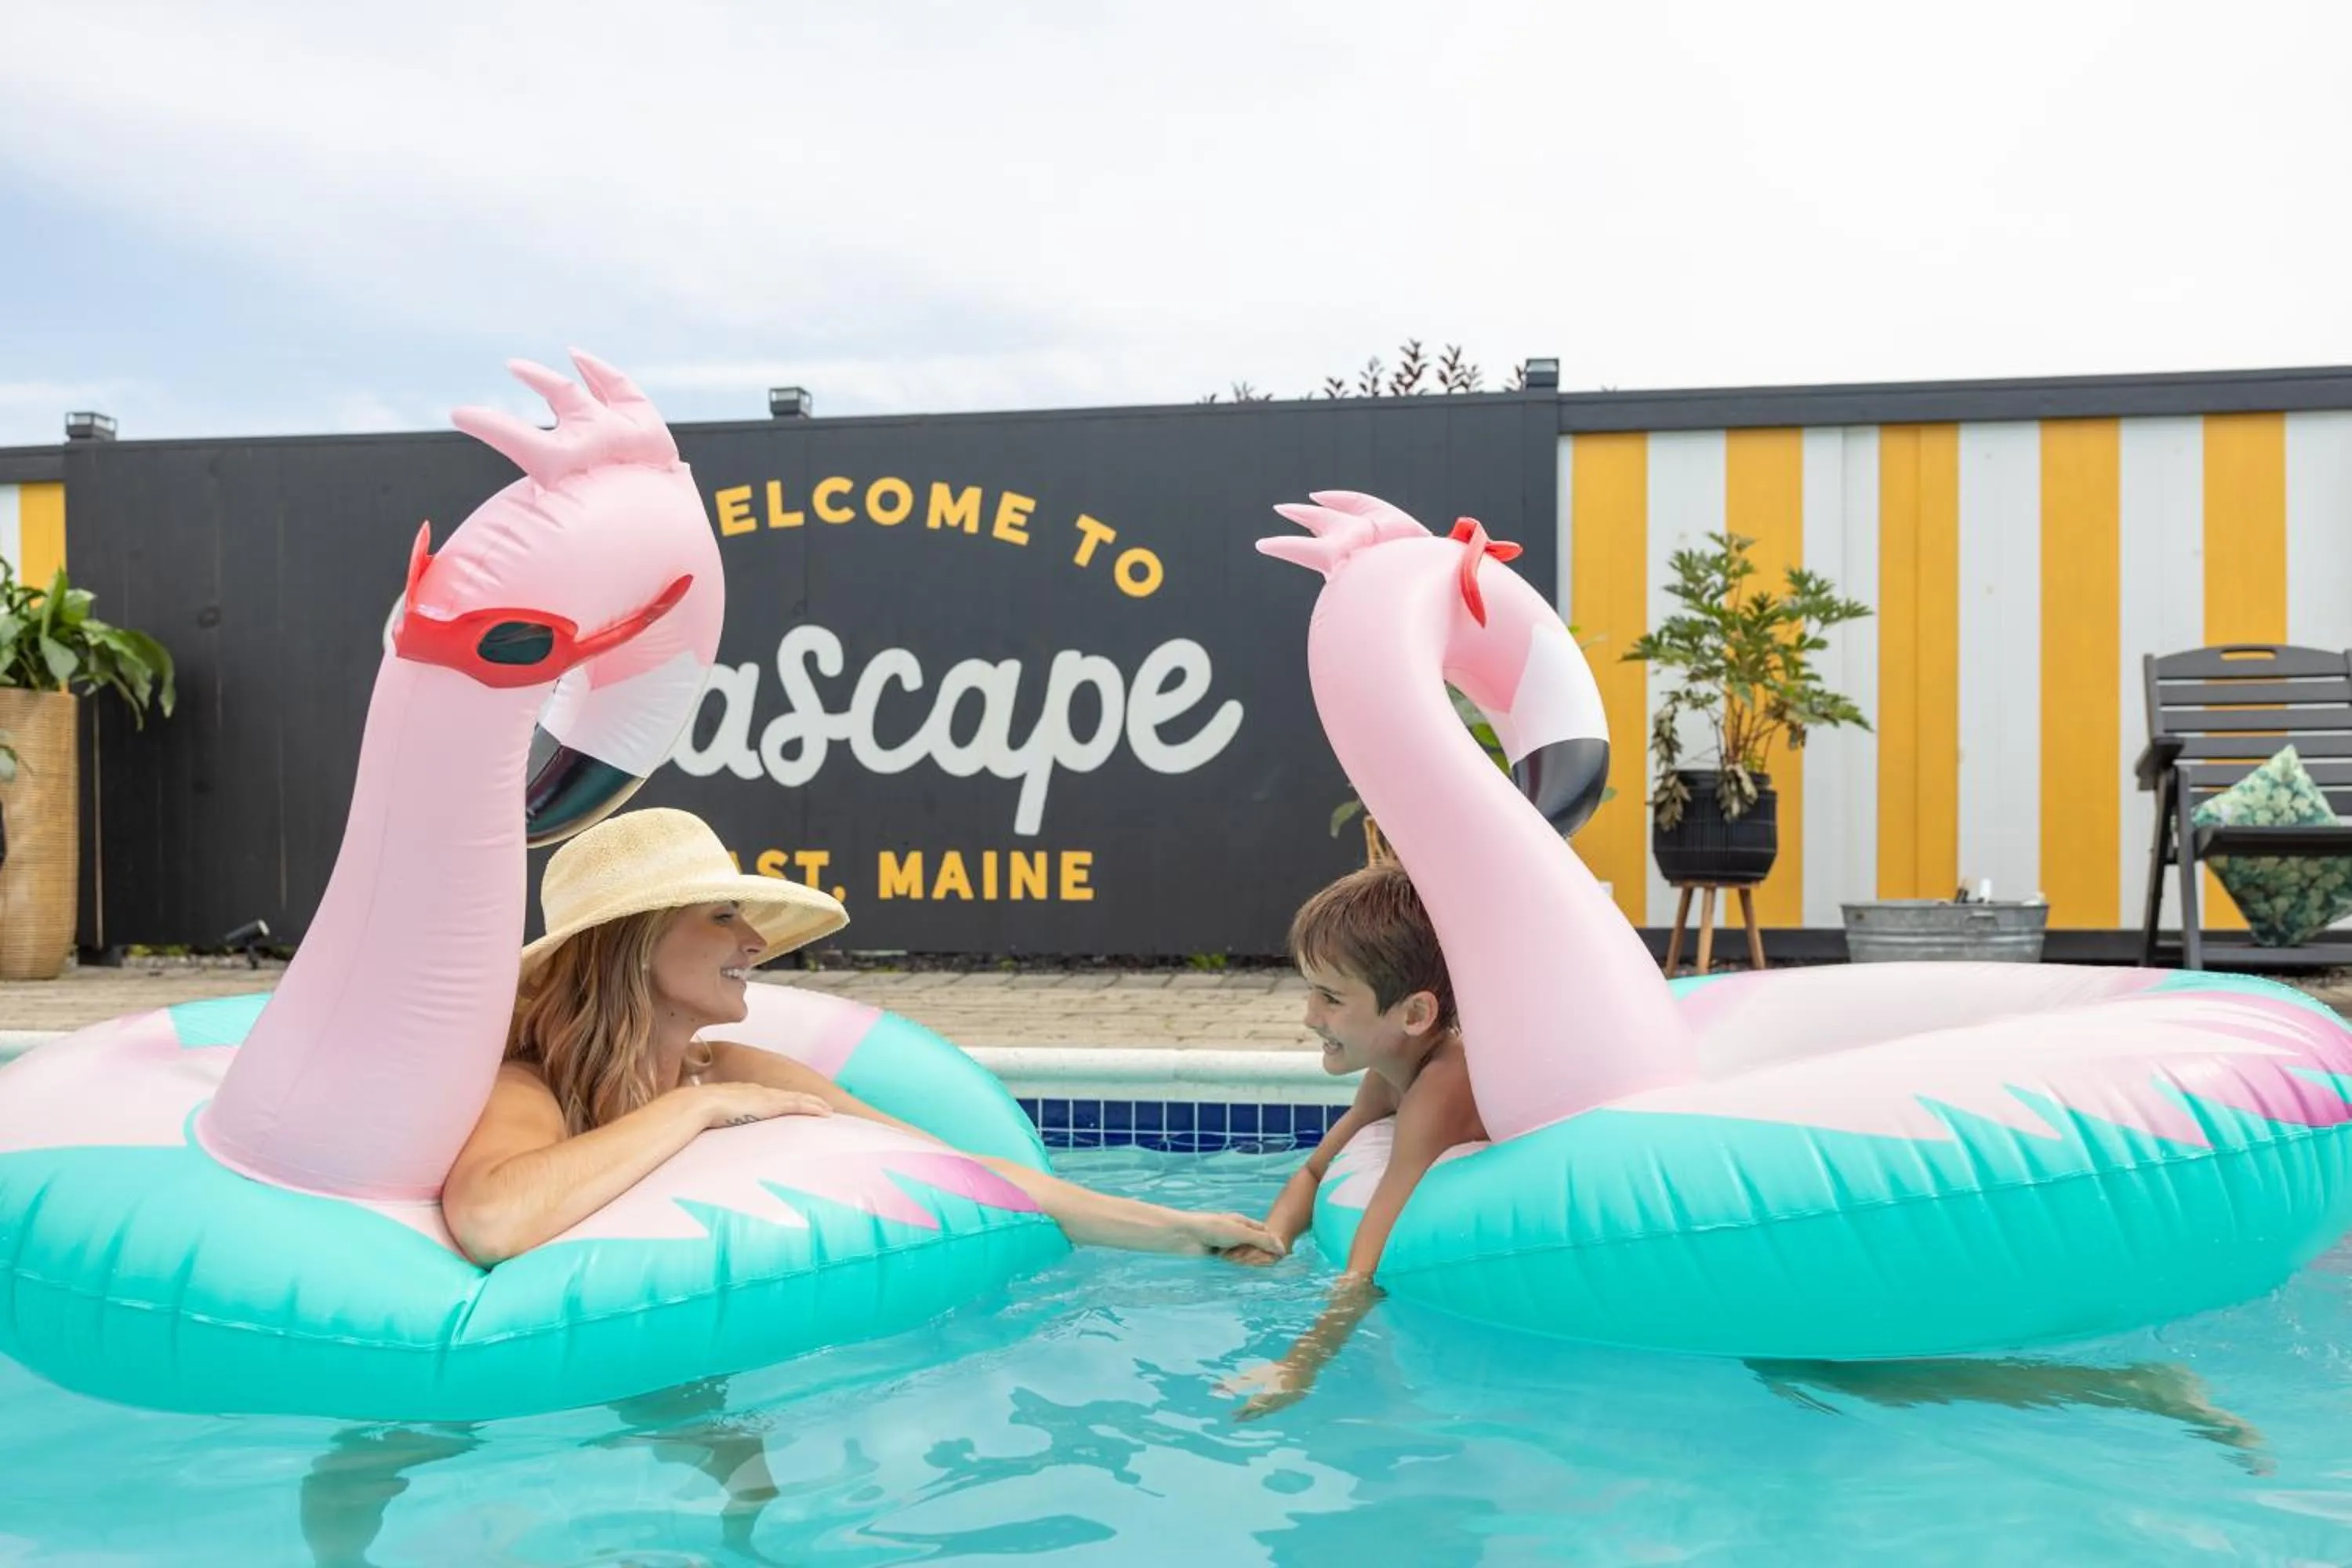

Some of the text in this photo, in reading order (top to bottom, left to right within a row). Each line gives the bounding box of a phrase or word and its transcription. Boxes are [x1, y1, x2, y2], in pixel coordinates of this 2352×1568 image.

[715, 477, 1163, 597] ELCOME TO
[649, 625, 1244, 836] ascape
[878, 850, 1094, 901] MAINE
